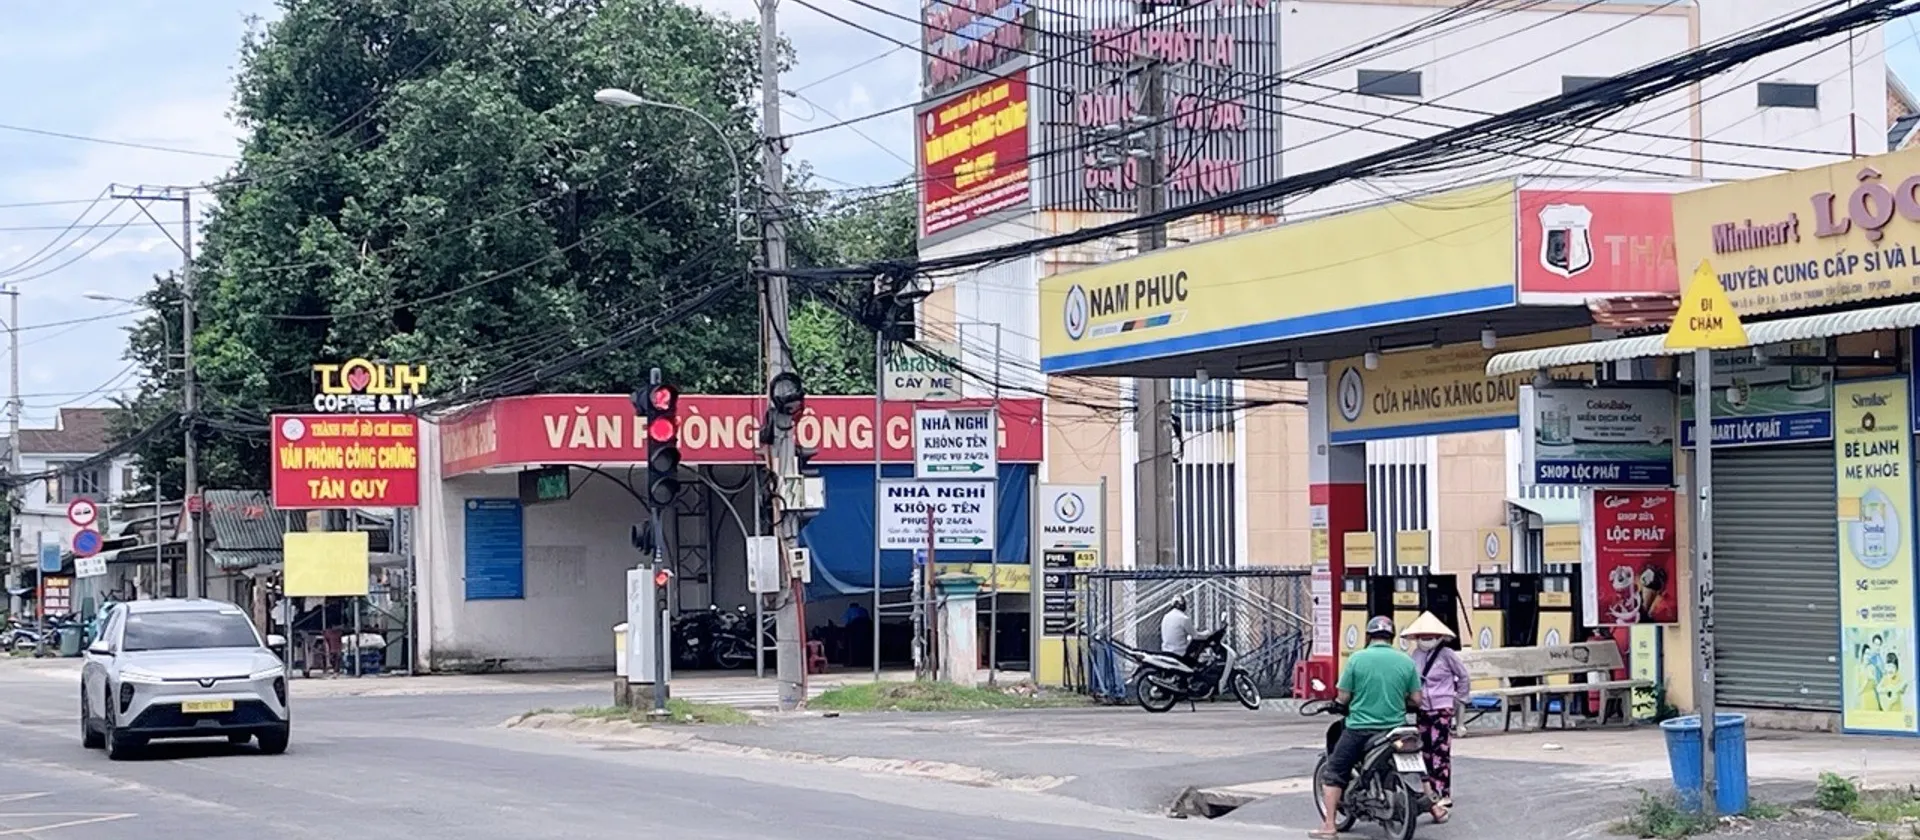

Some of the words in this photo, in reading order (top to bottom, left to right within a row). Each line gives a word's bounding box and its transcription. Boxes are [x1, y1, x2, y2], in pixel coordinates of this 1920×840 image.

[1711, 212, 1801, 255] Minimart
[1717, 264, 1769, 293] HUYÊN
[1773, 260, 1819, 286] CUNG
[1824, 248, 1859, 278] CẤP
[1885, 242, 1906, 269] VÀ
[1090, 283, 1129, 318] NAM
[1135, 270, 1188, 310] PHUC
[1700, 298, 1713, 312] ĐI
[1689, 316, 1723, 333] CHẬM
[895, 374, 924, 389] CÂY
[378, 394, 391, 412] &
[1372, 383, 1399, 415] CỬA
[1402, 383, 1441, 412] HÀNG
[1444, 379, 1482, 408] XĂNG
[543, 405, 622, 449] VĂN
[633, 404, 760, 450] PÒNG
[796, 408, 874, 450] ÔNG
[922, 414, 951, 431] NHÀ
[955, 412, 989, 431] NGHỈ
[1755, 418, 1782, 439] PHÁT
[924, 433, 963, 449] KHÔNG
[966, 433, 988, 448] TÊN
[279, 442, 303, 469] VĂN
[304, 440, 344, 469] PHÒNG
[345, 441, 377, 469] CÔNG
[963, 452, 990, 461] 24/24
[1540, 464, 1571, 480] SHOP
[1572, 463, 1591, 483] LỘC
[1592, 463, 1621, 480] PHÁT
[307, 475, 345, 500] TÂN
[350, 479, 389, 500] QUY
[887, 485, 931, 498] NHÀ
[937, 484, 987, 499] NGHỈ
[893, 501, 947, 514] KHÔNG
[952, 501, 981, 514] TÊN
[1044, 525, 1066, 534] NAM
[1606, 525, 1631, 545] LỘC
[1633, 525, 1666, 541] PHÁT
[1046, 553, 1068, 562] FUEL
